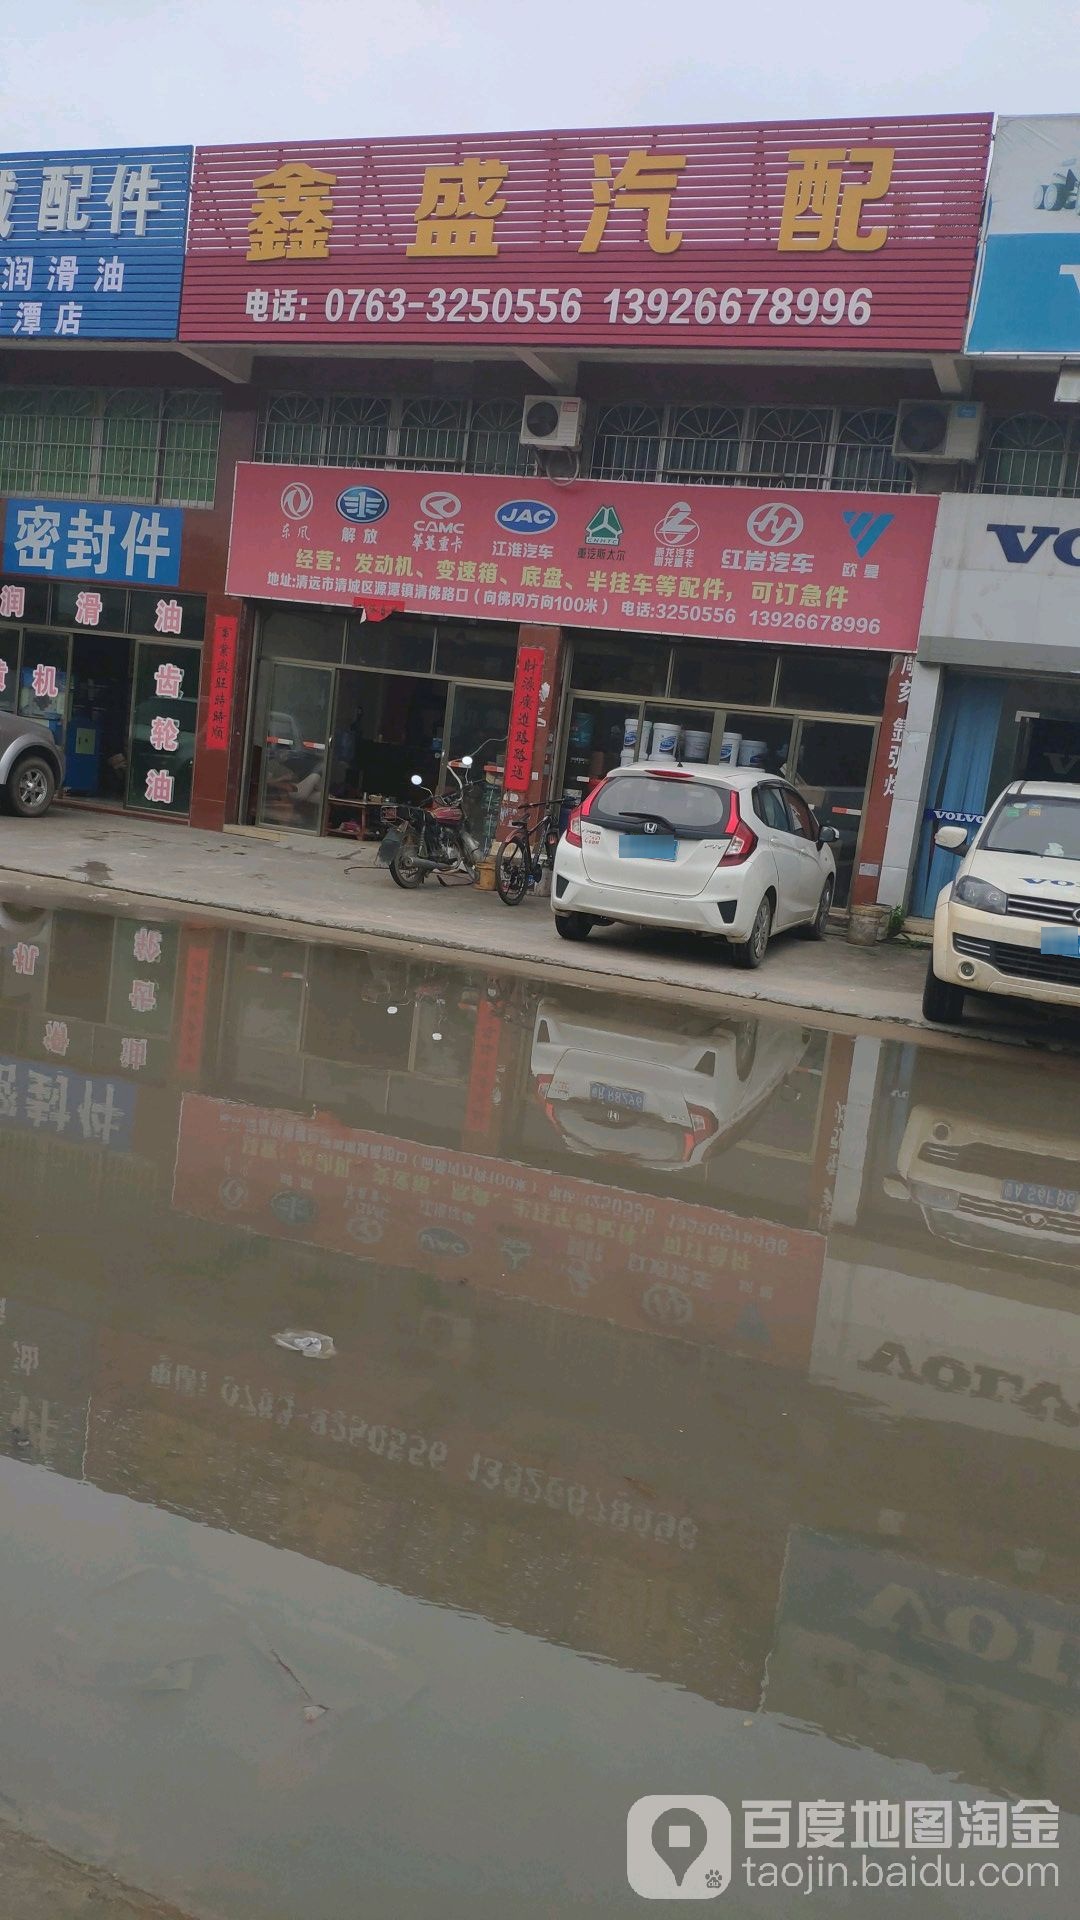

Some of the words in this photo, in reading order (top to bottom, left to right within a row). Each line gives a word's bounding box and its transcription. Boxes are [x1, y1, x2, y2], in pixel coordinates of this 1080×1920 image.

[246, 147, 896, 261] 鑫盛汽配
[2, 256, 124, 292] 润滑油
[0, 302, 82, 335] 潭店
[603, 287, 873, 326] 13926678996
[413, 520, 464, 535] CAMC
[502, 508, 550, 525] JAC
[14, 505, 171, 579] 密封件
[280, 523, 311, 542] 东风
[341, 527, 378, 544] 解放
[491, 541, 554, 558] 江淮汽车
[721, 549, 815, 574] 红岩汽车
[842, 562, 880, 579] 欧曼
[0, 585, 183, 634] 润滑油
[749, 610, 881, 635] 13926678996
[145, 663, 184, 804] 齿轮油
[1018, 877, 1080, 887] VO
